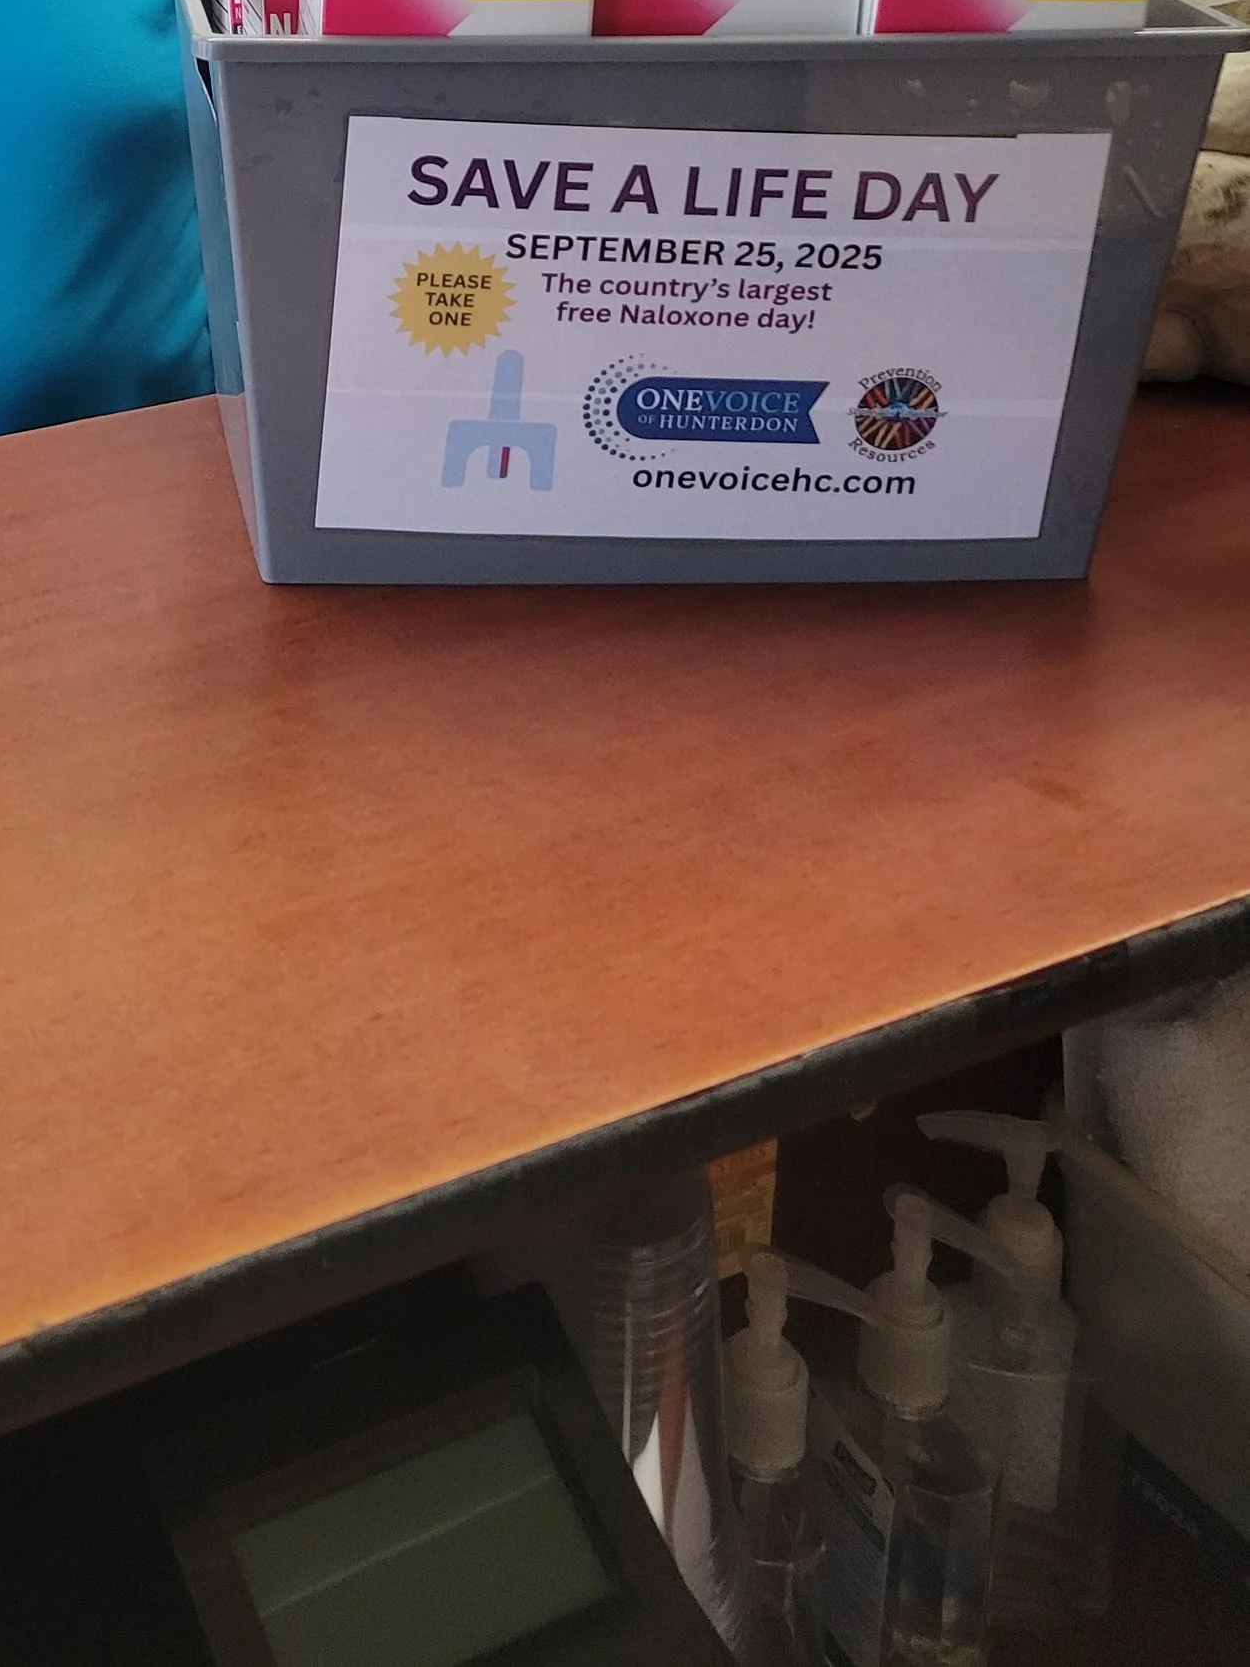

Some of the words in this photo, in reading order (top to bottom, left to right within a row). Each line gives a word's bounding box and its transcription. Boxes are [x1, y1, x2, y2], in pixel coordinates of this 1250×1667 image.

[407, 154, 594, 212] SAVE
[610, 164, 659, 215] A
[683, 166, 833, 220] LIFE
[853, 170, 1000, 223] DAY
[505, 233, 725, 266] SEPTEMBER
[734, 240, 784, 274] 25,
[794, 242, 883, 270] 2025
[416, 272, 493, 290] PLEASE
[541, 272, 592, 294] The
[599, 276, 730, 303] country's
[738, 278, 833, 305] largest
[425, 291, 475, 308] TAKE
[428, 310, 473, 327] ONE
[556, 301, 612, 323] free
[620, 303, 750, 328] Naloxone
[756, 307, 816, 334] day!
[858, 367, 943, 393] Prevention
[636, 387, 801, 414] ONEVOICE
[638, 414, 656, 424] OF
[659, 413, 799, 433] HUNTERDON
[848, 436, 937, 463] Resources
[632, 465, 916, 495] onevoicehc.com
